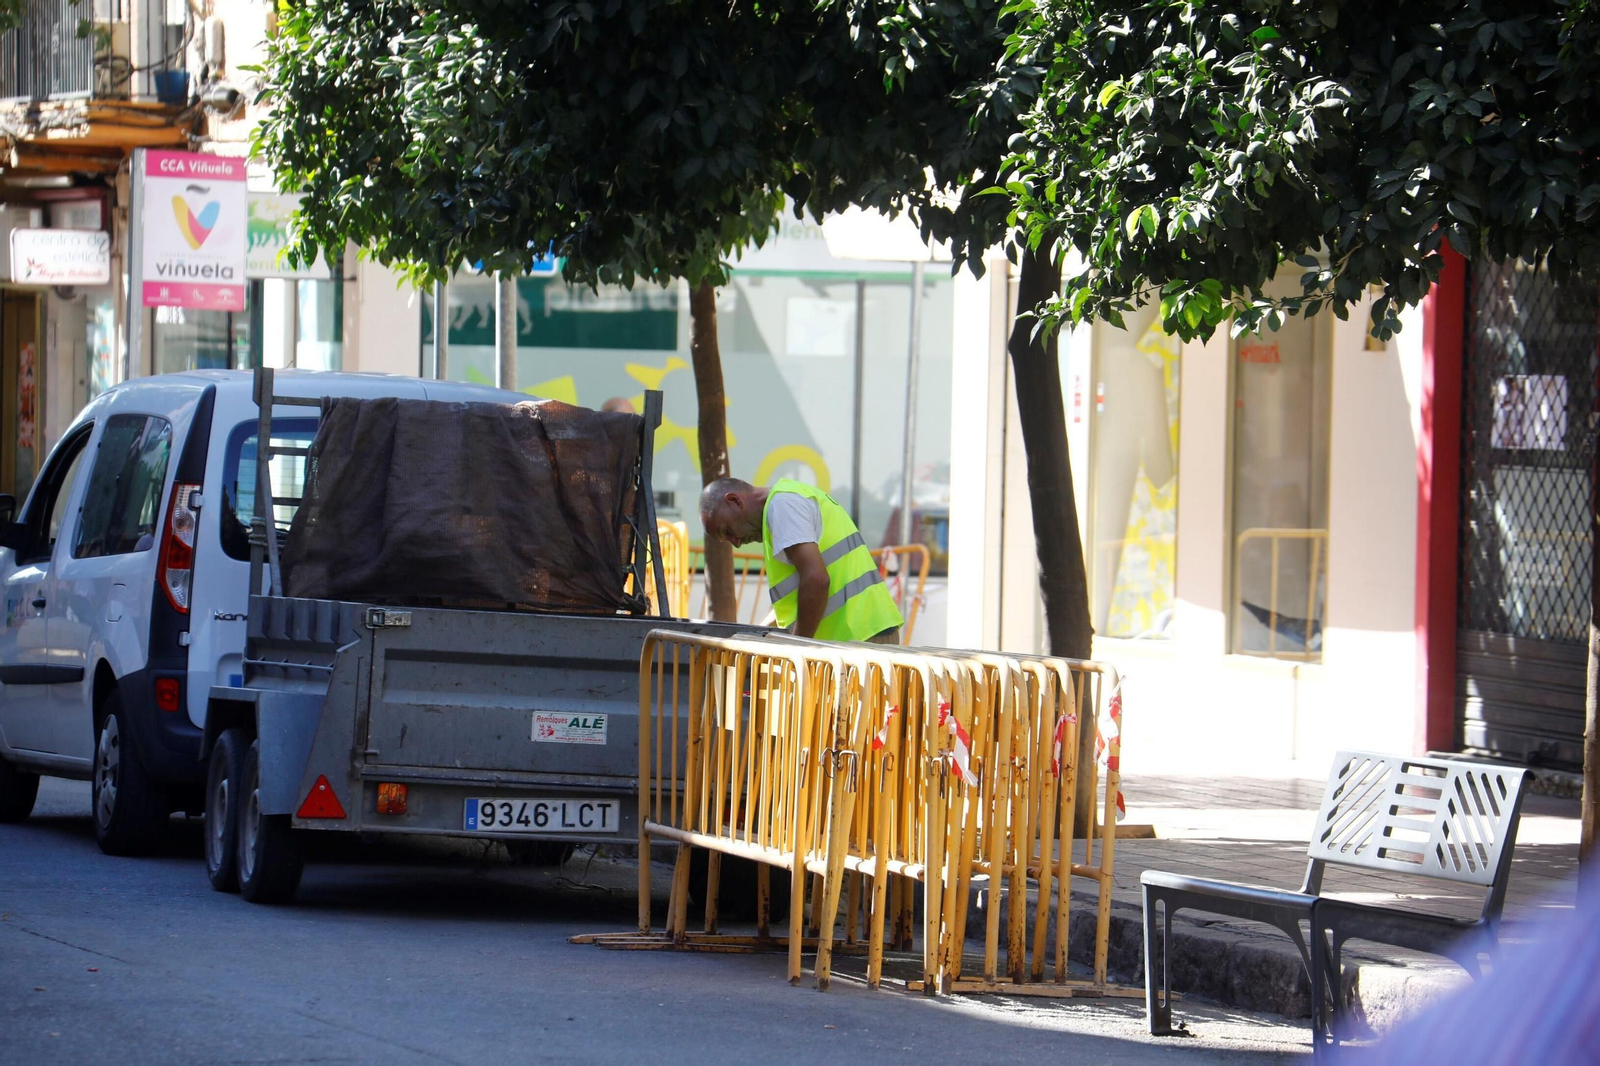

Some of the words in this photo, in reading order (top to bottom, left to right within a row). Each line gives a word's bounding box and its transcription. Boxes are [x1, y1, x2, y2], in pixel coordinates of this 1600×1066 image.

[160, 158, 185, 172] CCA
[189, 160, 234, 175] Viñuela
[155, 258, 234, 280] viñuela
[568, 716, 605, 729] ALÉ
[468, 817, 475, 825] E
[480, 802, 549, 828] 9346
[562, 802, 612, 828] LCT
